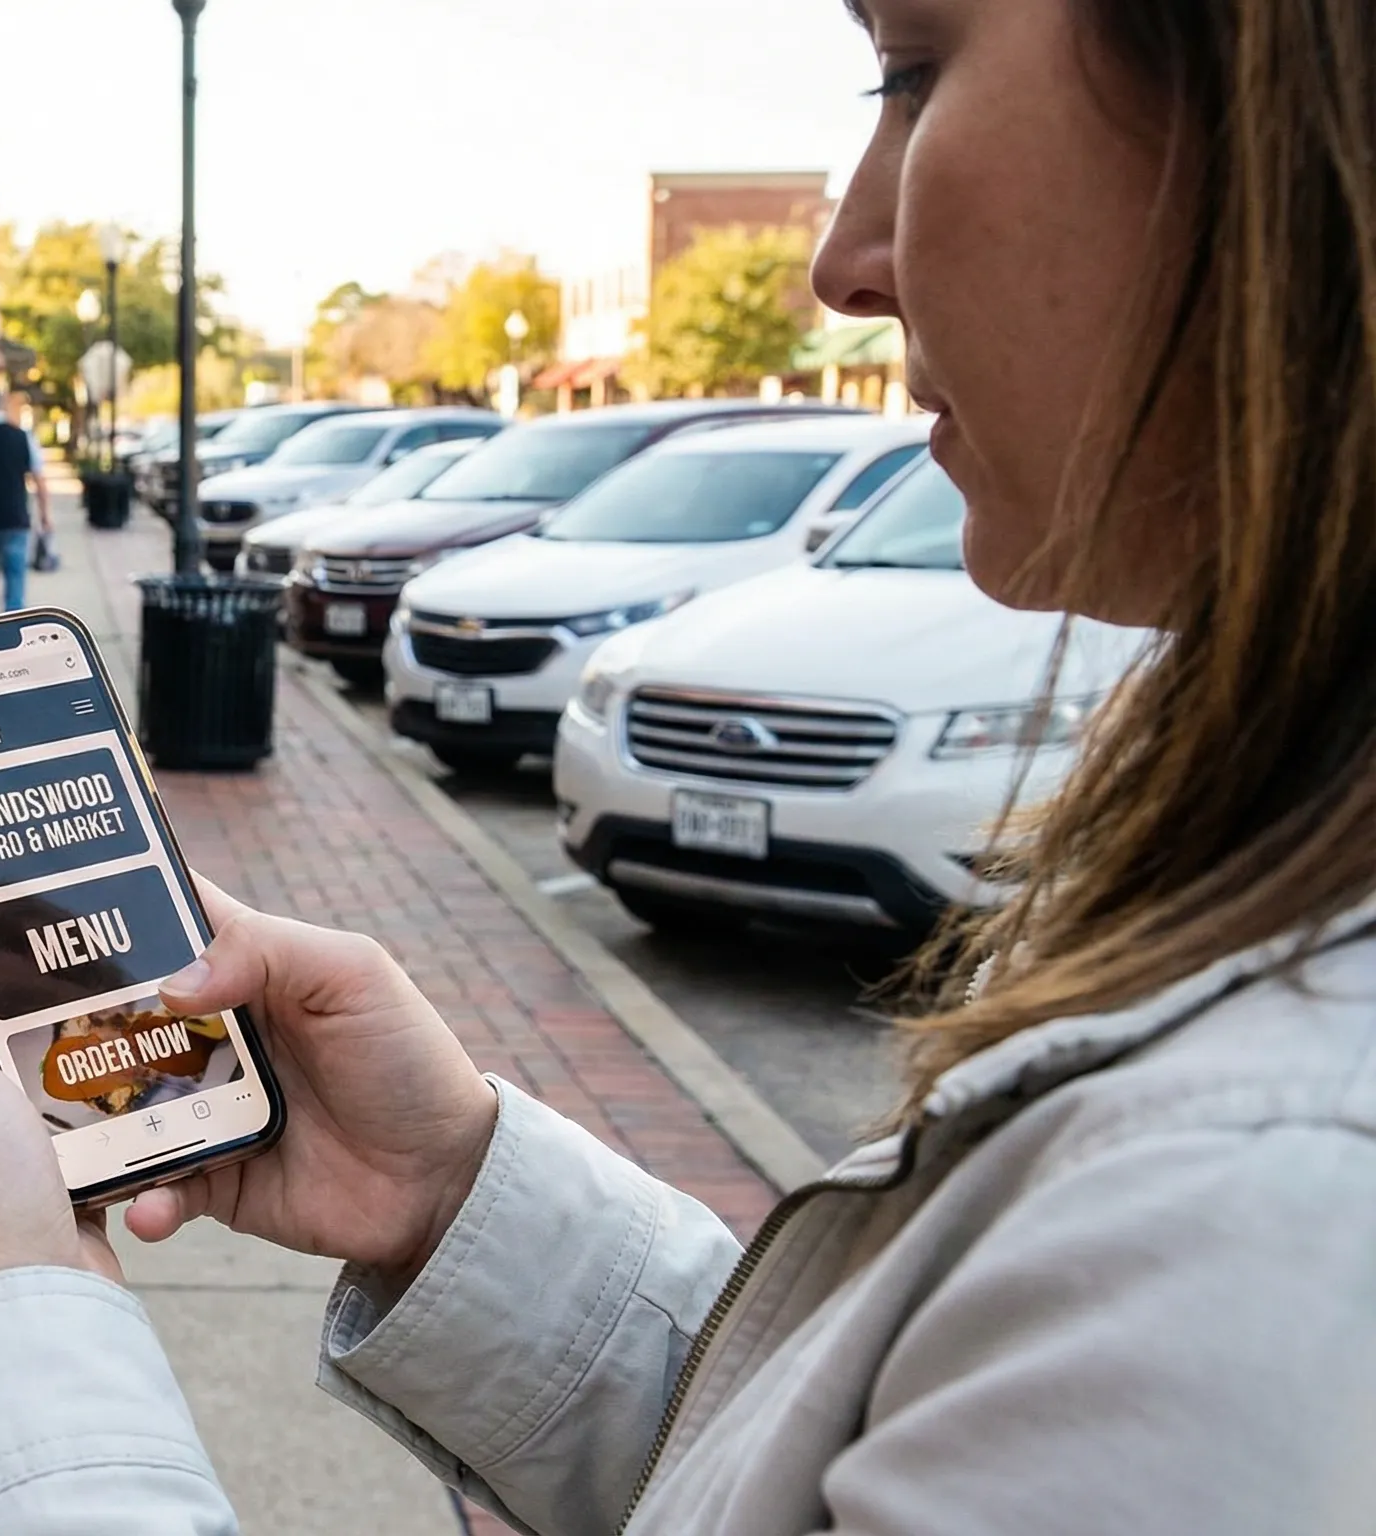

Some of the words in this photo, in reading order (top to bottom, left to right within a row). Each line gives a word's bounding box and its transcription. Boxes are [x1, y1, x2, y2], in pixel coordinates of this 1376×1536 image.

[25, 827, 44, 853] &
[42, 807, 125, 849] MARKET
[25, 907, 132, 974] MENU
[56, 1037, 136, 1086] ORDER
[135, 1021, 192, 1063] NOW
